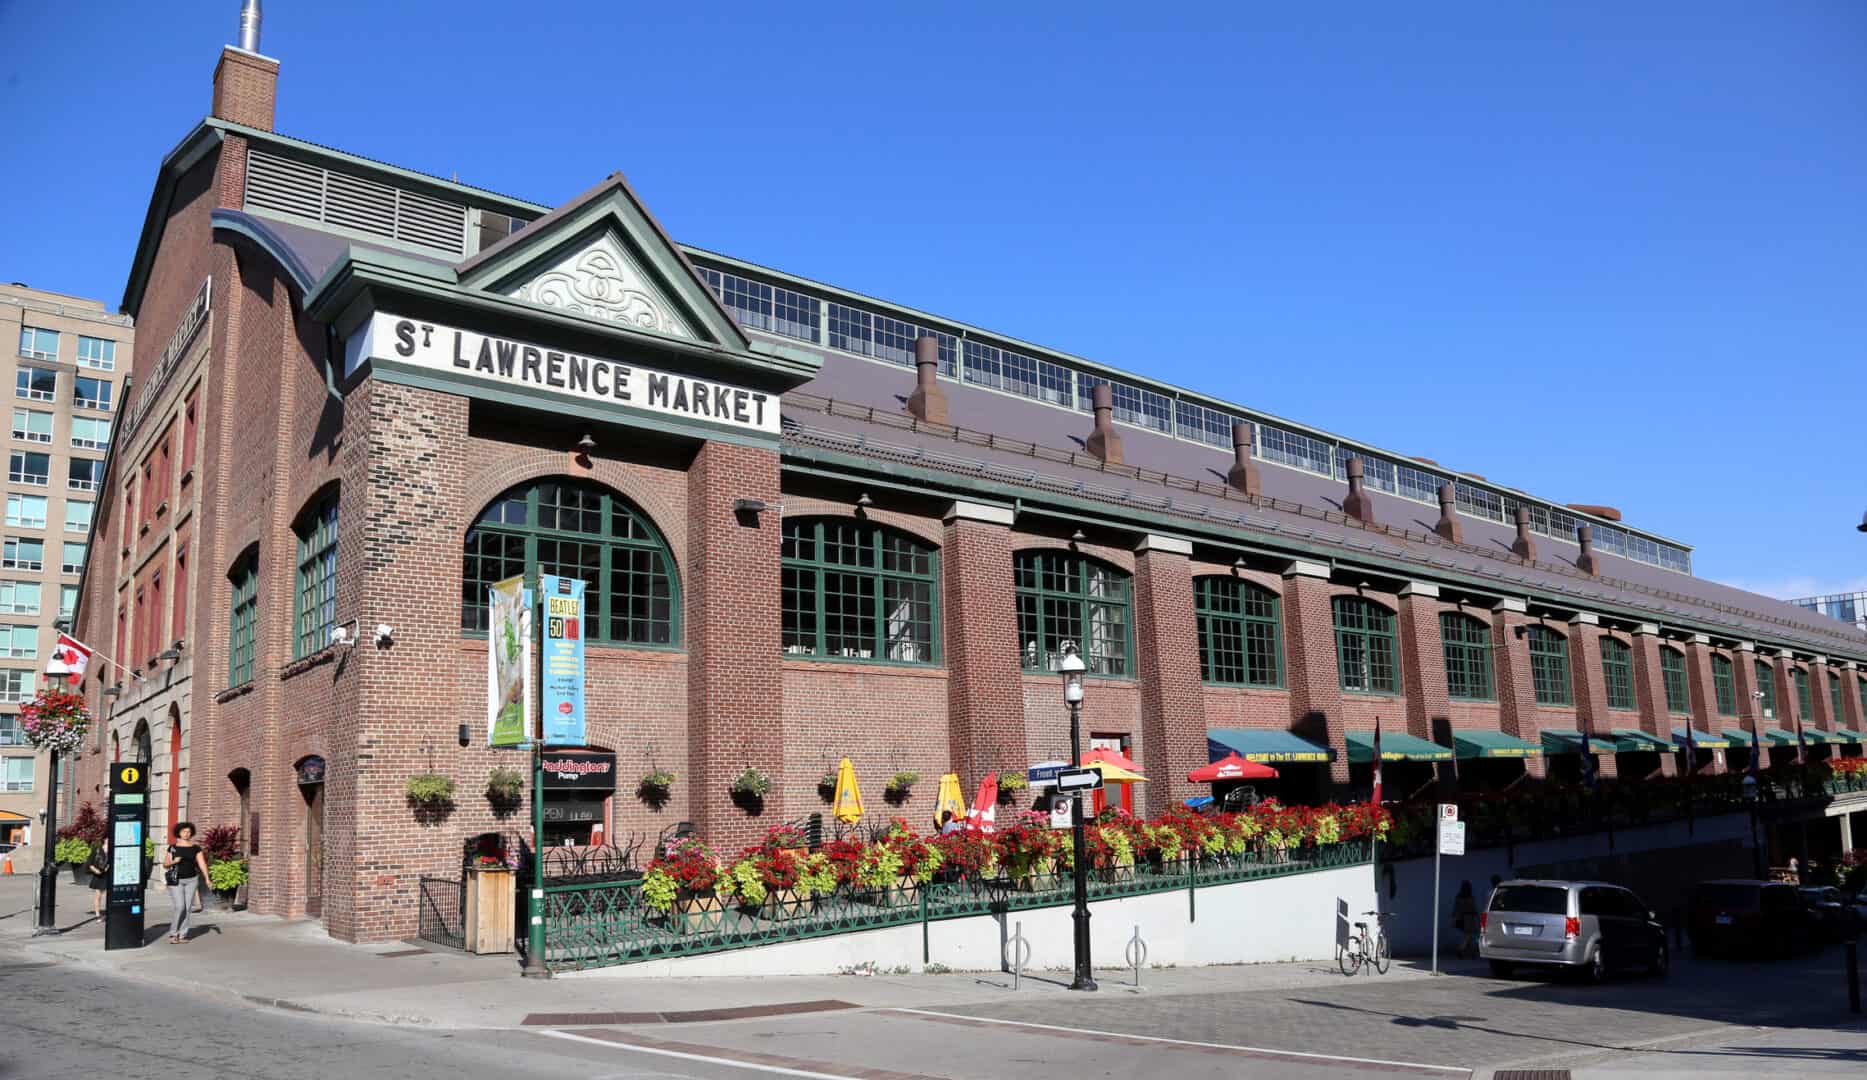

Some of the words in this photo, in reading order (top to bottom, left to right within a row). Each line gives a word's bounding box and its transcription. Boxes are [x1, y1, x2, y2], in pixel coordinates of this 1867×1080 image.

[453, 331, 632, 401] LAWRENCE
[648, 373, 768, 426] MARKET
[550, 618, 562, 637] 50
[558, 772, 579, 780] Pump
[542, 807, 564, 820] PEN
